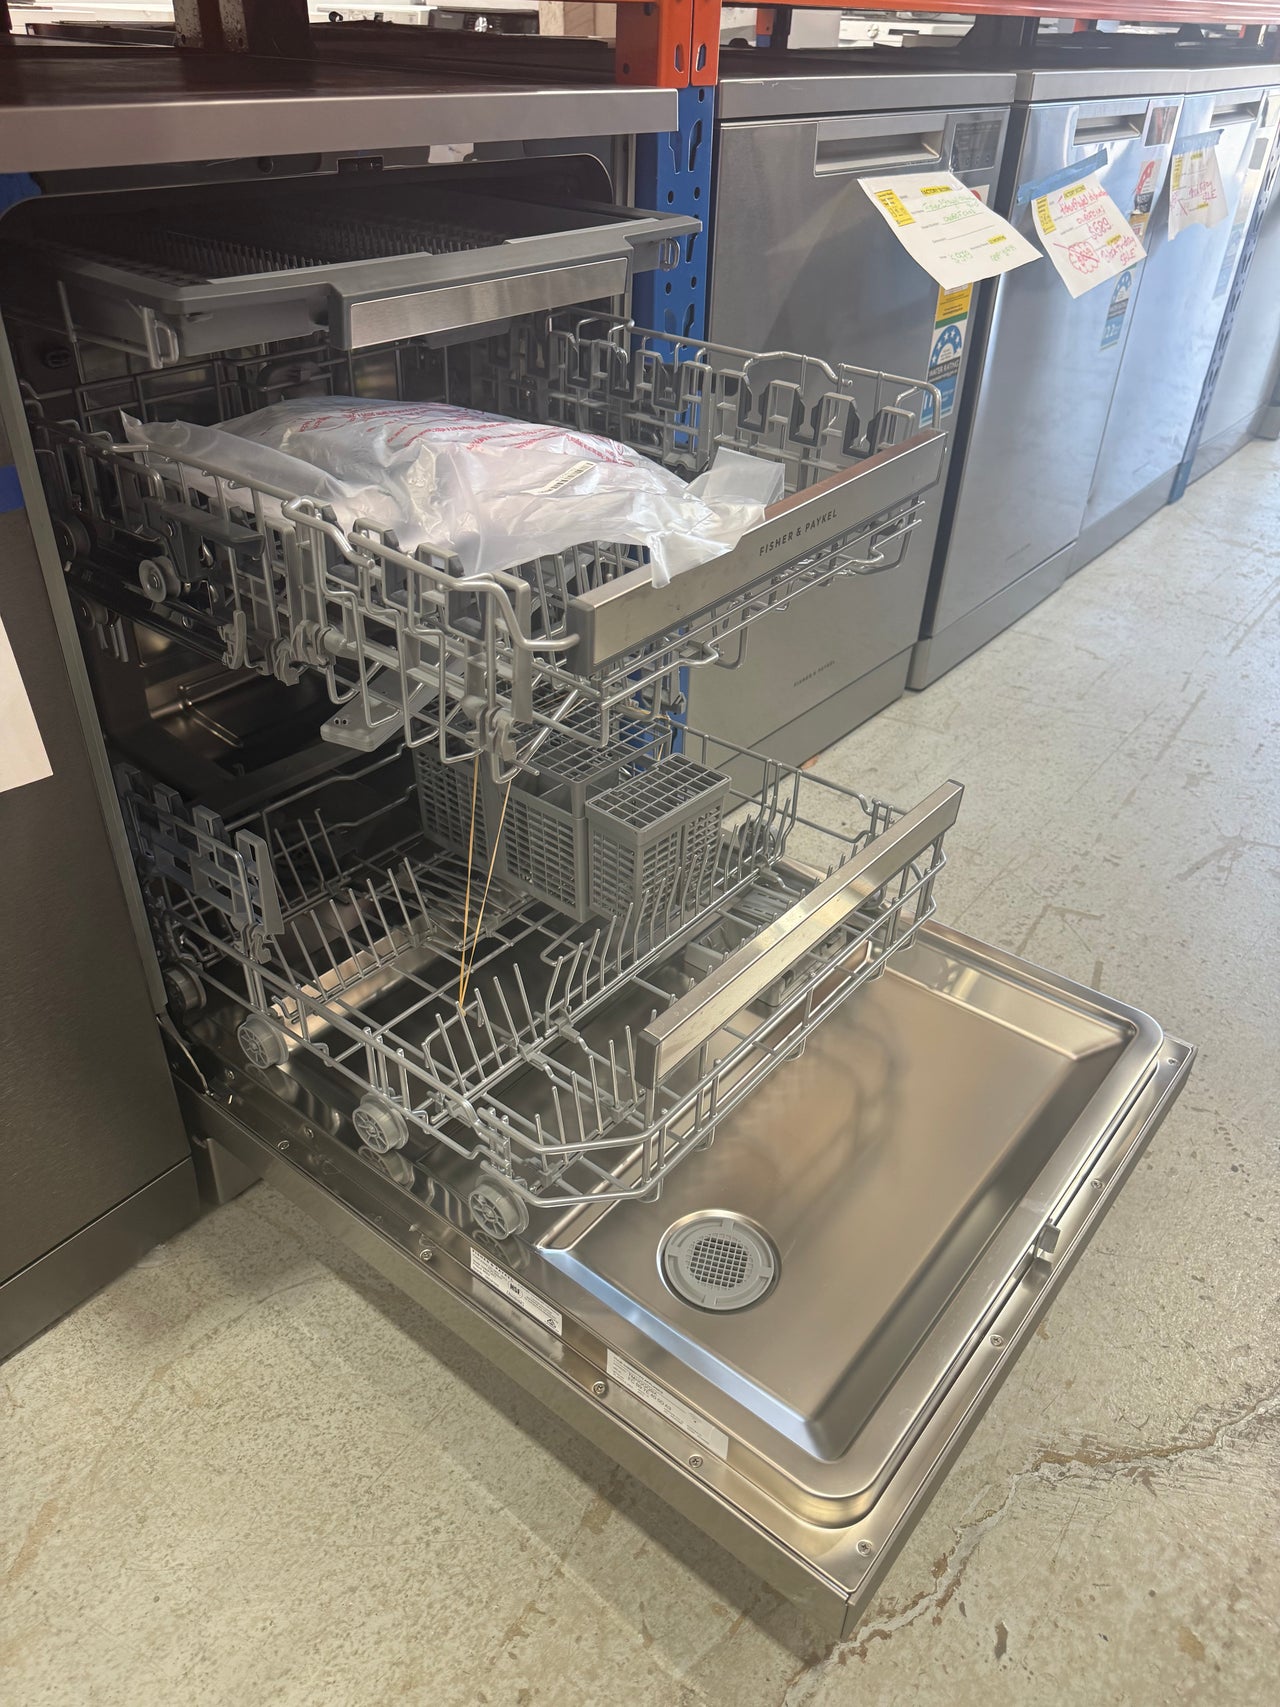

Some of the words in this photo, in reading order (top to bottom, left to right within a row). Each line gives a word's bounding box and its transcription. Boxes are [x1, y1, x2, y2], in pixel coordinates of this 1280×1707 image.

[759, 531, 794, 556] FISHER
[796, 527, 802, 537] &
[804, 509, 838, 533] PAYKEL
